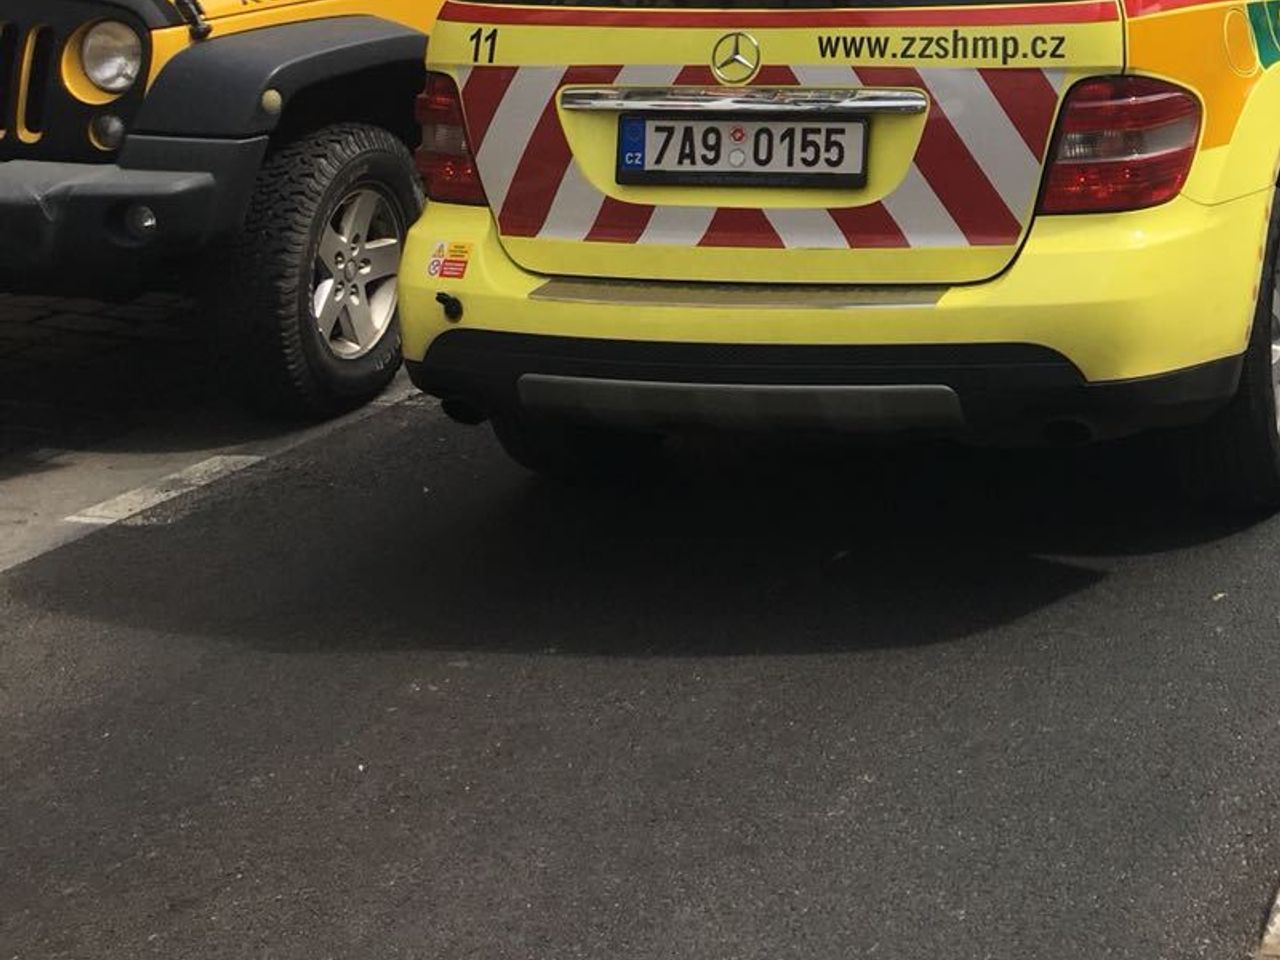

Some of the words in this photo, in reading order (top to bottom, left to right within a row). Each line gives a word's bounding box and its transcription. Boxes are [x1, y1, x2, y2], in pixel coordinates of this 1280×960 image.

[469, 27, 499, 63] 11
[817, 29, 1066, 65] www.zzshmp.cz
[625, 152, 643, 165] CZ
[653, 126, 723, 167] 7A9
[752, 127, 846, 168] 0155
